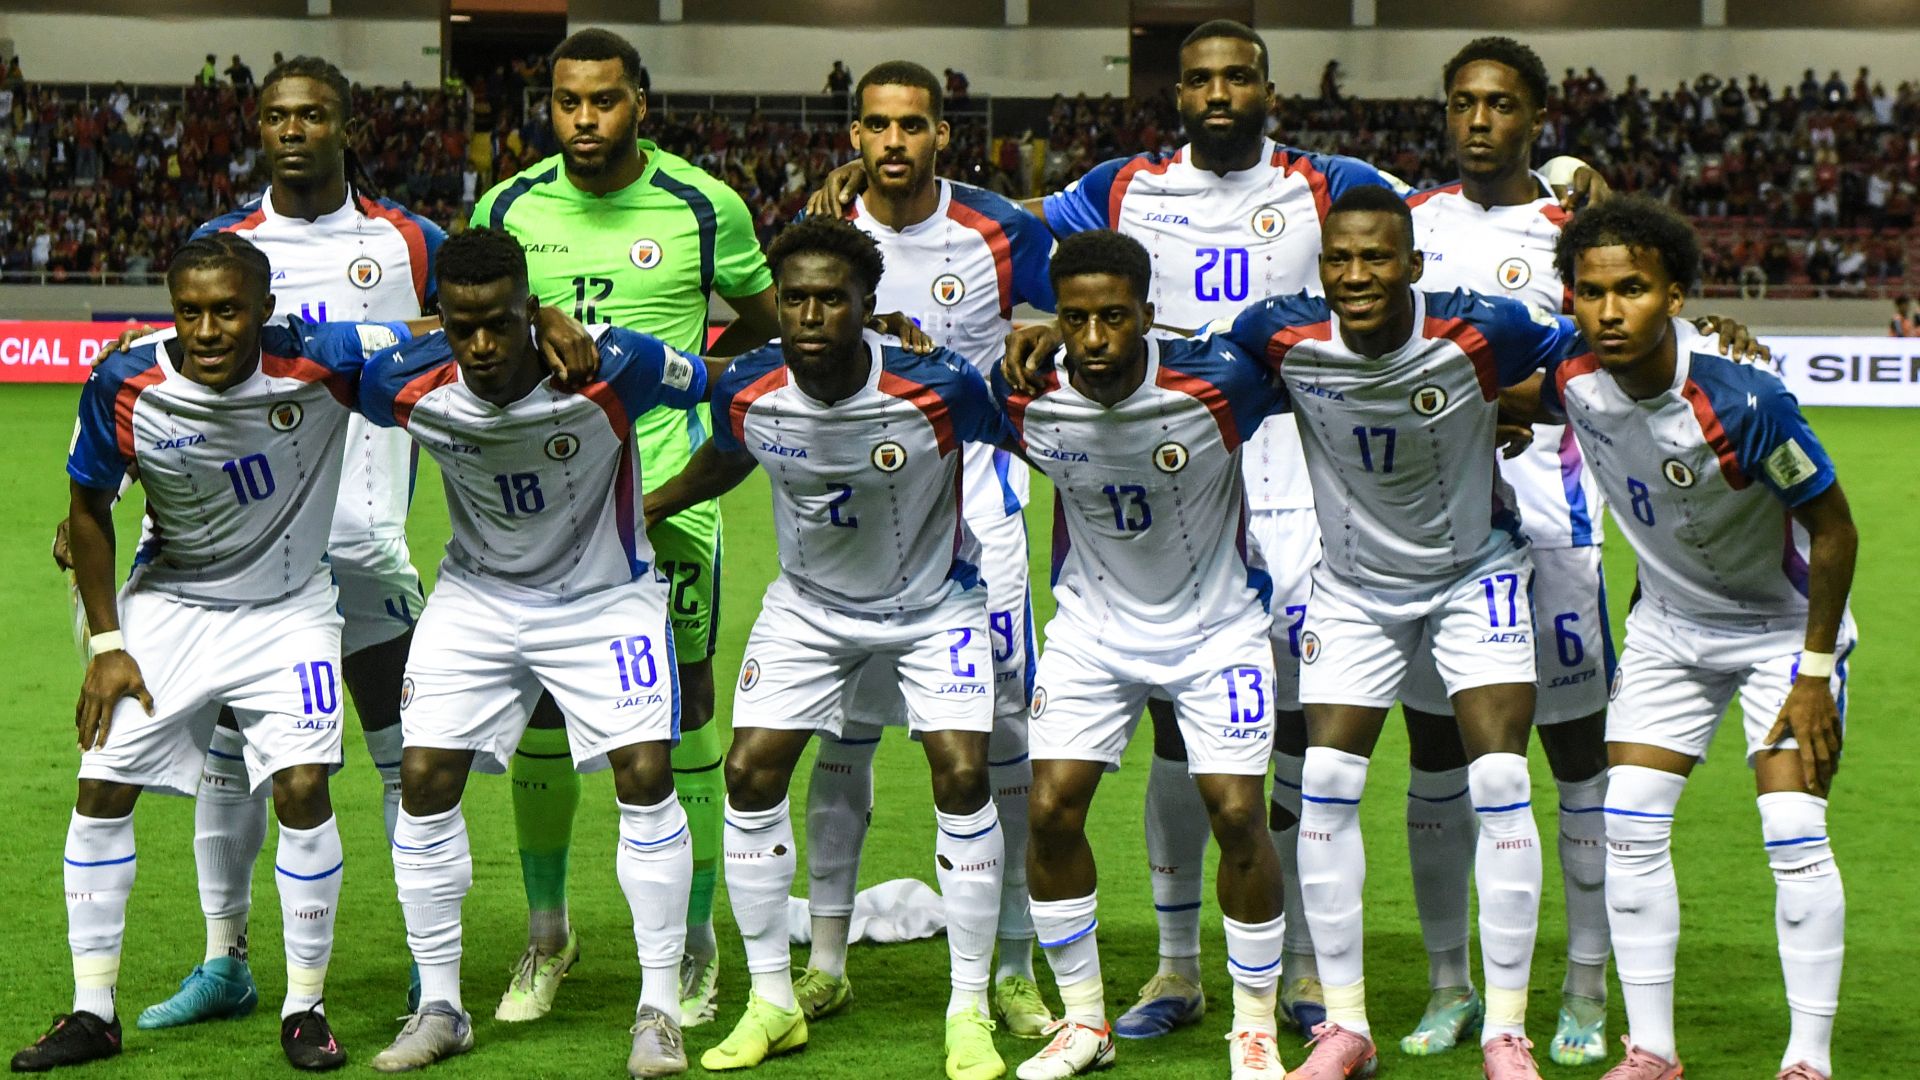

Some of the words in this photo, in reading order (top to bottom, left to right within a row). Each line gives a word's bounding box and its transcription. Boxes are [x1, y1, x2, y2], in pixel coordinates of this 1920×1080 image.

[1143, 213, 1188, 225] SAETA
[1195, 248, 1249, 302] 20
[572, 277, 614, 326] 12
[1, 337, 70, 366] CIAL
[1298, 381, 1344, 401] SAETA
[153, 434, 206, 449] SAETA
[760, 442, 807, 458] SAETA
[1043, 449, 1088, 462] SAETA
[1352, 426, 1396, 473] 17
[222, 453, 276, 506] 10
[494, 472, 546, 515] 18
[826, 482, 858, 529] 2
[1102, 484, 1153, 532] 13
[1627, 476, 1655, 527] 8
[1479, 573, 1518, 628] 17
[673, 620, 700, 629] ETA
[990, 611, 1015, 663] 9
[1478, 632, 1528, 643] SAETA
[1554, 611, 1584, 668] 6
[609, 634, 659, 693] 18
[947, 627, 976, 678] 2
[292, 660, 338, 716] 10
[936, 683, 987, 694] SAETA
[995, 669, 1018, 681] ETA
[1549, 669, 1597, 688] SAETA
[613, 694, 663, 710] SAETA
[1221, 668, 1266, 724] 13
[294, 719, 337, 730] SAETA
[1220, 727, 1268, 740] SAETA
[1497, 837, 1533, 849] HAITI
